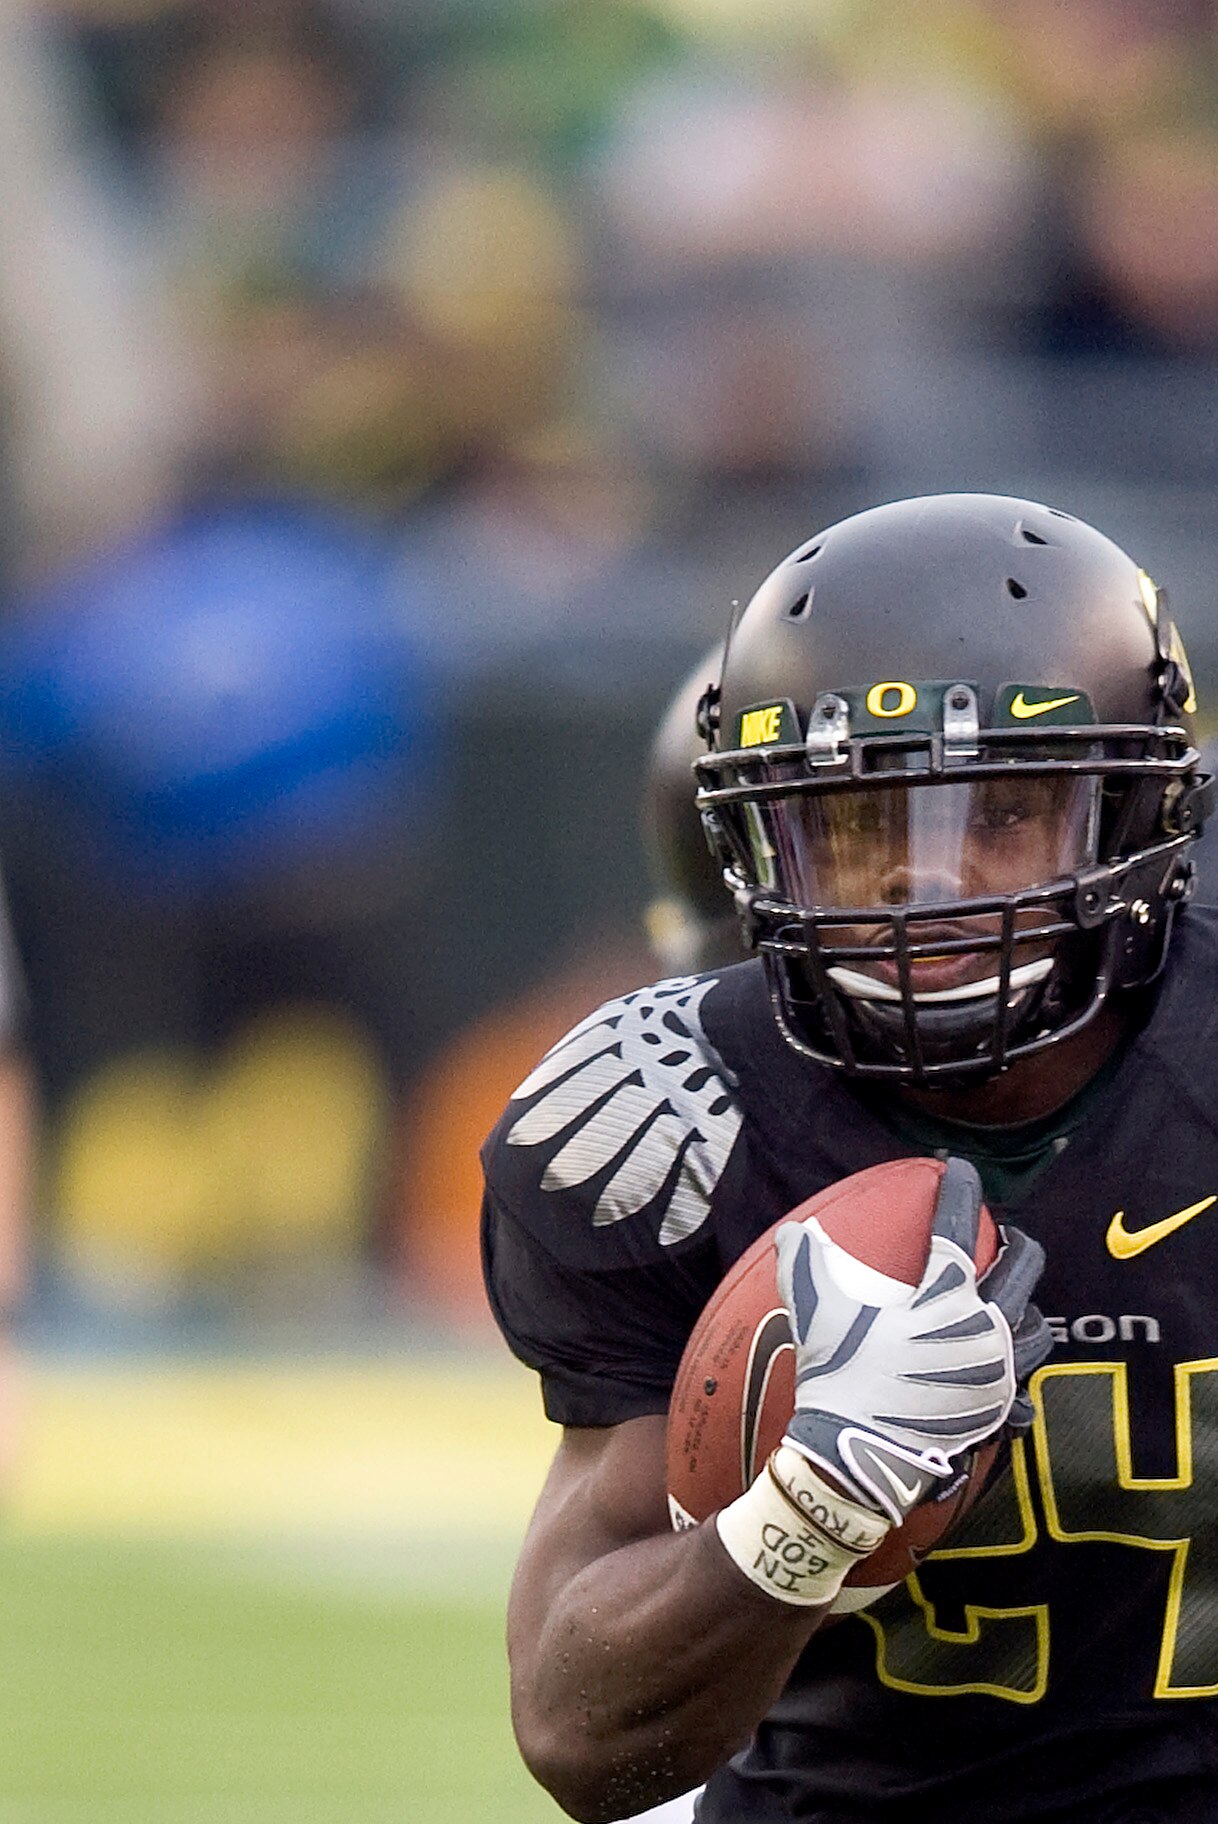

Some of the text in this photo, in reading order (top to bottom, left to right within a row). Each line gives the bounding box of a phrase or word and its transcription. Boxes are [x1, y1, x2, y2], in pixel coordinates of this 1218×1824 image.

[866, 680, 917, 718] O
[740, 705, 784, 749] NIKE
[752, 1549, 807, 1594] IN
[761, 1522, 830, 1577] GOD
